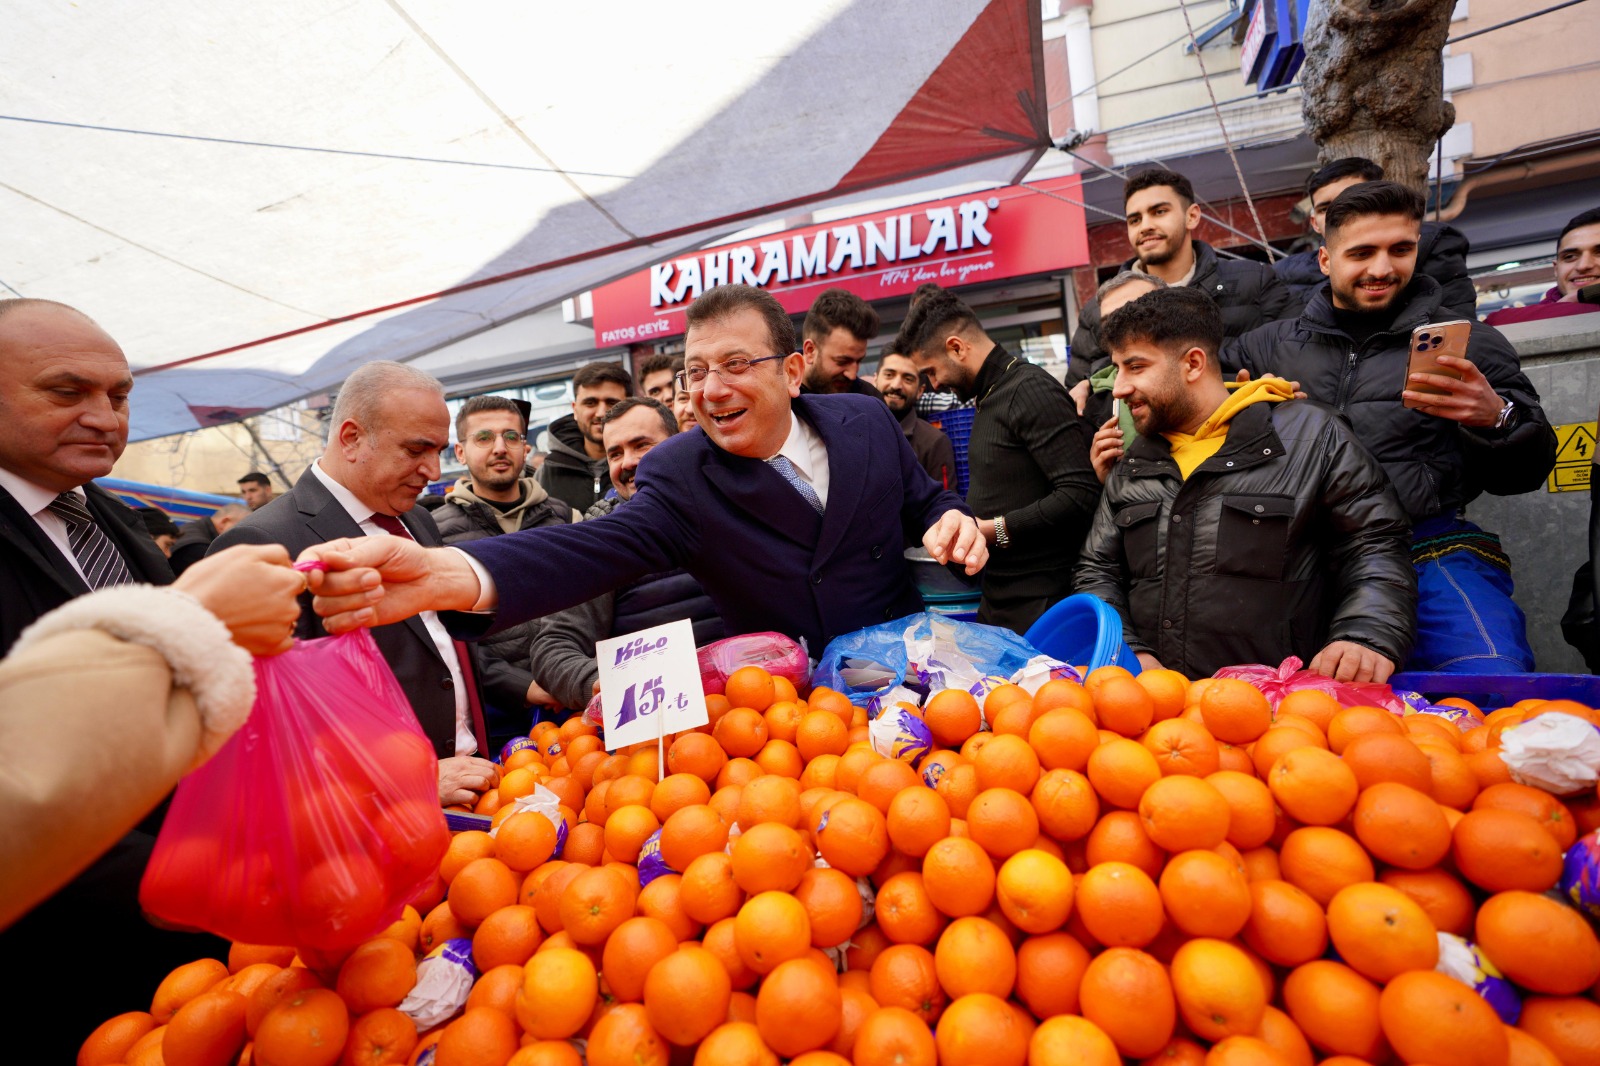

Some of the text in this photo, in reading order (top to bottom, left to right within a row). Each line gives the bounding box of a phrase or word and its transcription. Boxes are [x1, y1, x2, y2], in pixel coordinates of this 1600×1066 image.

[880, 261, 994, 287] 1974'den bu yana
[601, 319, 670, 342] FATOŞ ÇEYİZ
